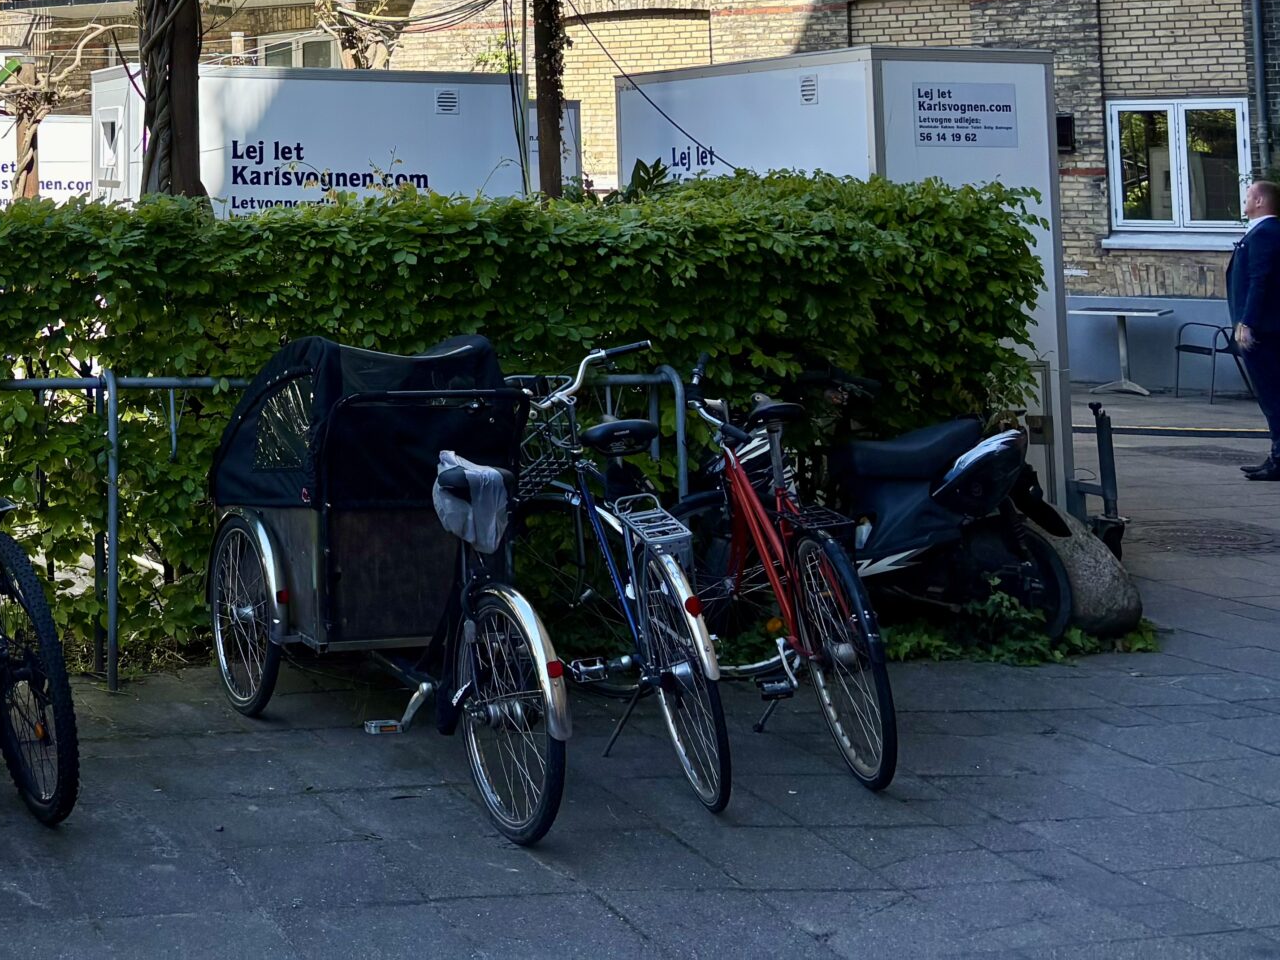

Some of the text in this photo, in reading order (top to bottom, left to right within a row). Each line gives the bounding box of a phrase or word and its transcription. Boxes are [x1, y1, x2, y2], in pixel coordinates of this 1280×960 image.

[917, 88, 952, 100] Lej let
[918, 101, 1012, 114] Karlsvognen.com
[919, 115, 952, 125] Letvogne
[919, 132, 977, 142] 56 14 19 62
[231, 140, 304, 165] Lej let
[671, 146, 715, 171] Lej let
